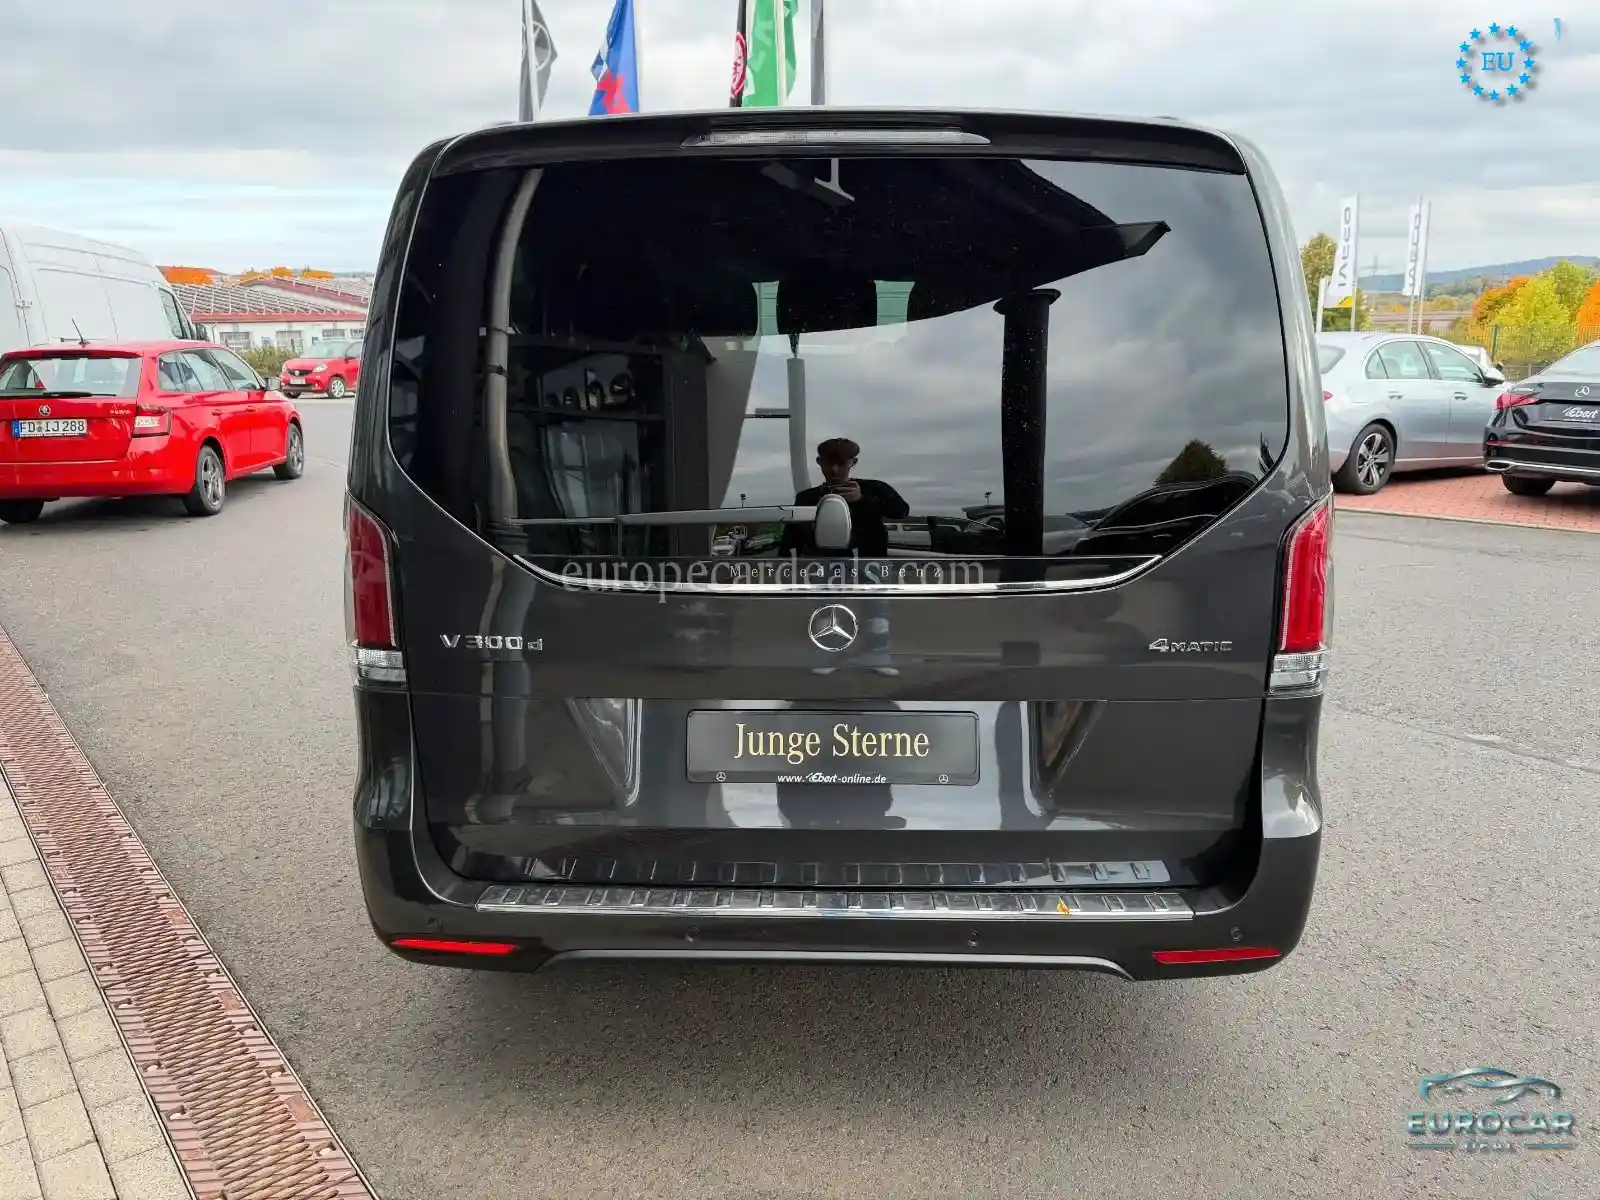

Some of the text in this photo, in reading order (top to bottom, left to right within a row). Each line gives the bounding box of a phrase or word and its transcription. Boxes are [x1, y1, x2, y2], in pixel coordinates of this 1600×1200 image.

[20, 421, 36, 433] FD
[62, 420, 85, 432] 288
[729, 565, 942, 578] Mercedes-Benz
[1149, 638, 1233, 652] 4MATIC
[733, 722, 930, 765] Junge Sterne
